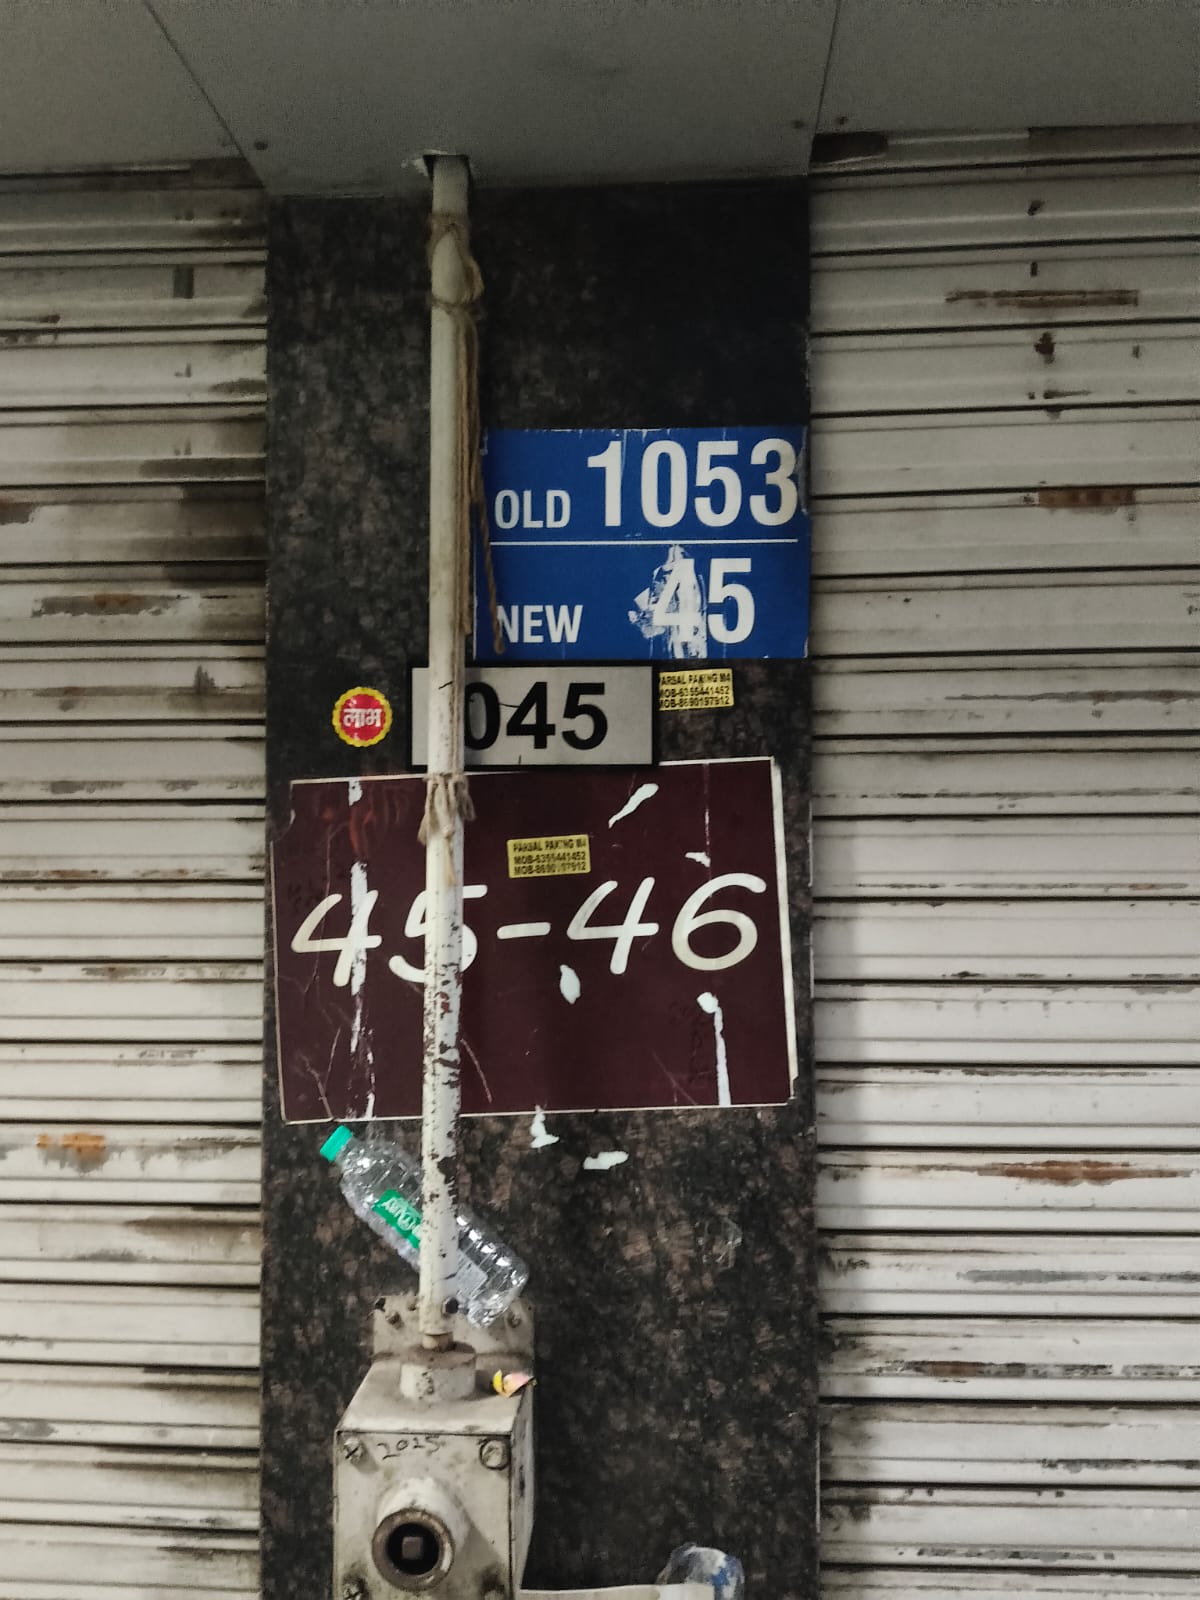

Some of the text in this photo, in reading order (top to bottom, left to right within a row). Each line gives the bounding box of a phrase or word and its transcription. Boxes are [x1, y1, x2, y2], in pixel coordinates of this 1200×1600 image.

[494, 438, 798, 529] OLD 1053
[496, 557, 756, 645] NEW 45
[343, 708, 383, 729] लाभ
[463, 681, 608, 751] 045
[376, 1434, 440, 1460] 2015
